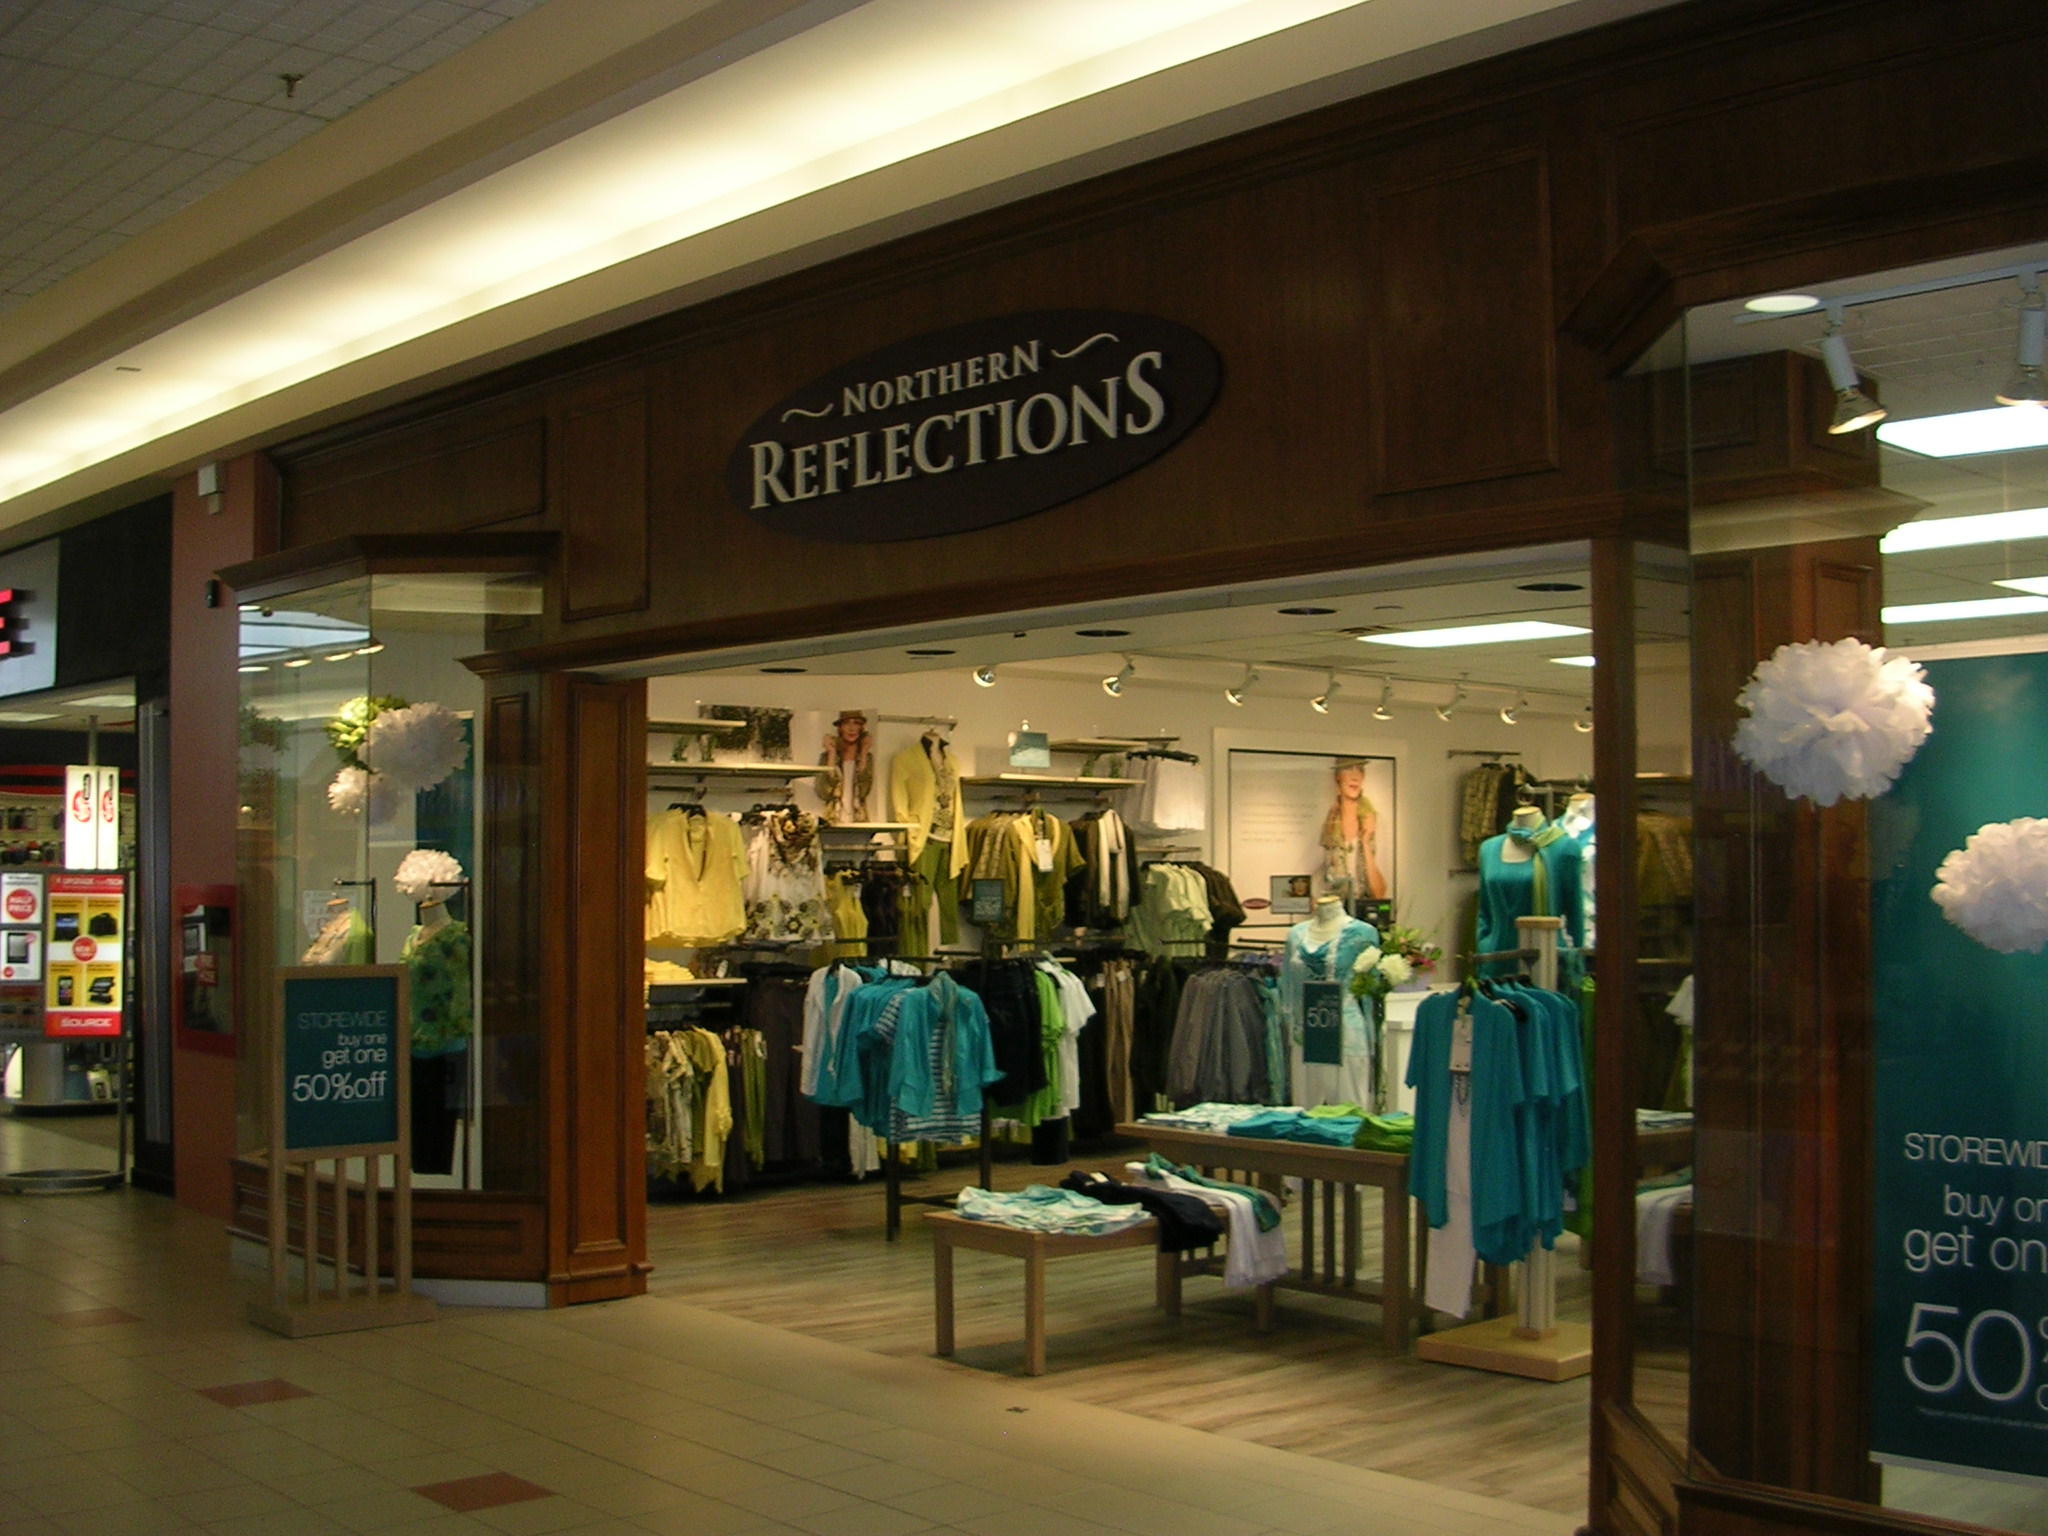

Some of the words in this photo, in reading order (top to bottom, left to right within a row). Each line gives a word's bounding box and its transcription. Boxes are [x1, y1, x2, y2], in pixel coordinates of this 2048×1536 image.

[842, 340, 1041, 417] NORTHERN
[750, 351, 1165, 509] REFLECTIONS
[299, 1011, 387, 1028] STOREWIDE
[338, 1033, 360, 1046] buy
[365, 1034, 387, 1044] one
[322, 1047, 351, 1069] get
[355, 1049, 387, 1063] one
[1944, 1184, 2004, 1226] buy
[1903, 1224, 1974, 1273] get
[1990, 1236, 2048, 1274] on
